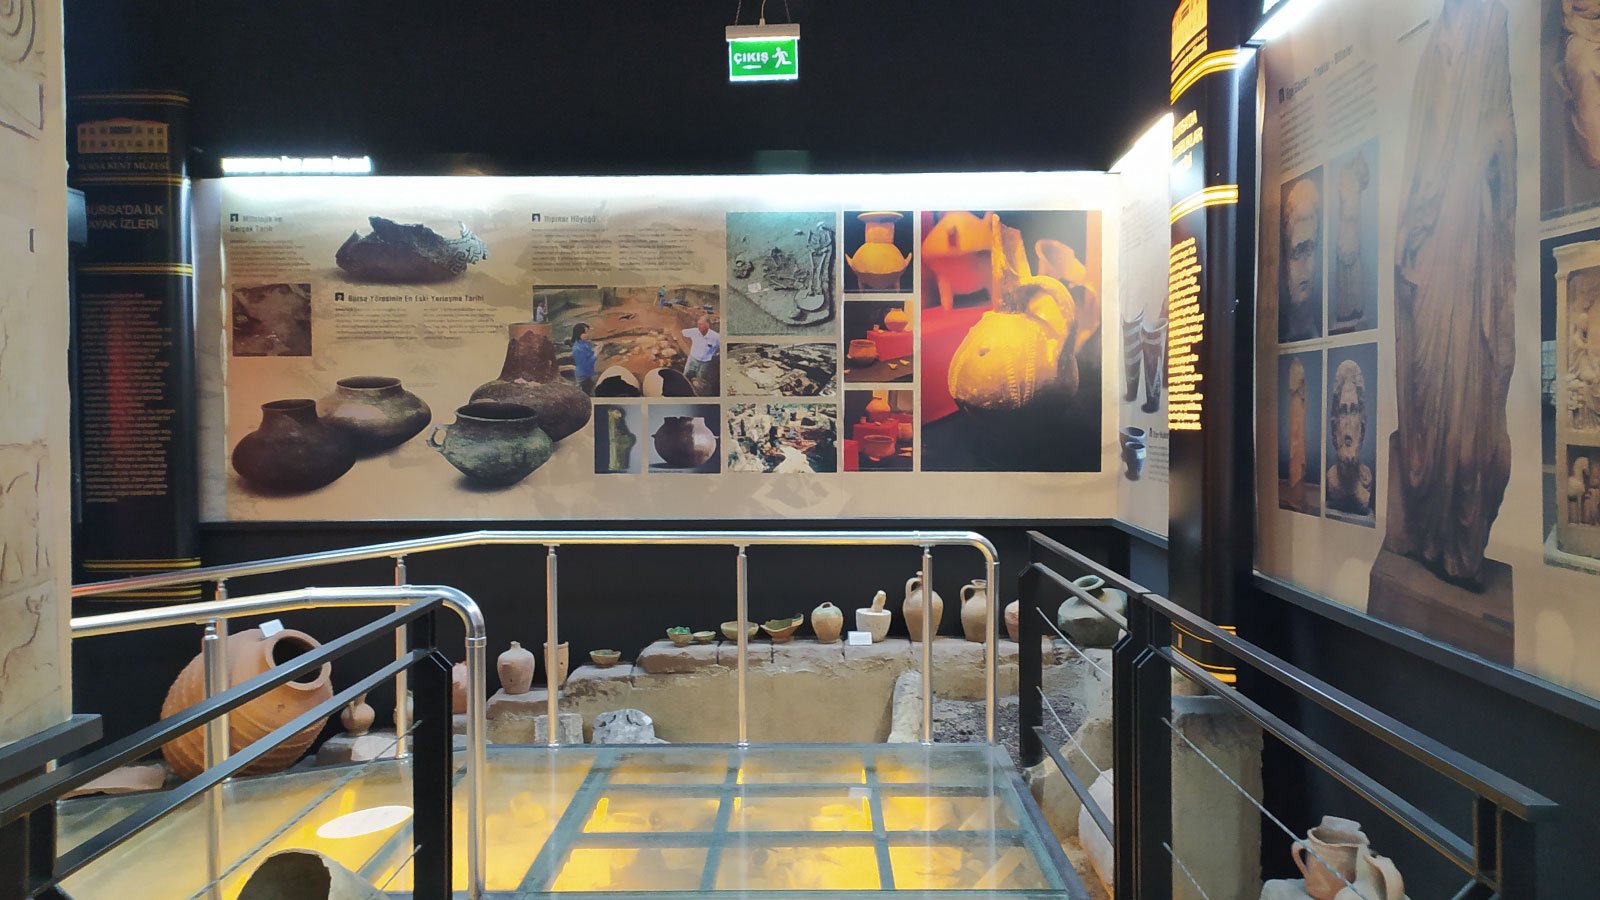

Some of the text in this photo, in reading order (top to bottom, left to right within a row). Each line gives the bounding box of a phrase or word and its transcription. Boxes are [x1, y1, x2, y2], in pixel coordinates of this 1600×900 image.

[733, 52, 769, 65] ÇIKIŞ
[144, 203, 164, 215] İLK
[120, 218, 159, 230] İZLERİ
[404, 294, 413, 302] En
[414, 294, 429, 302] Eski
[464, 294, 485, 302] Tarihi
